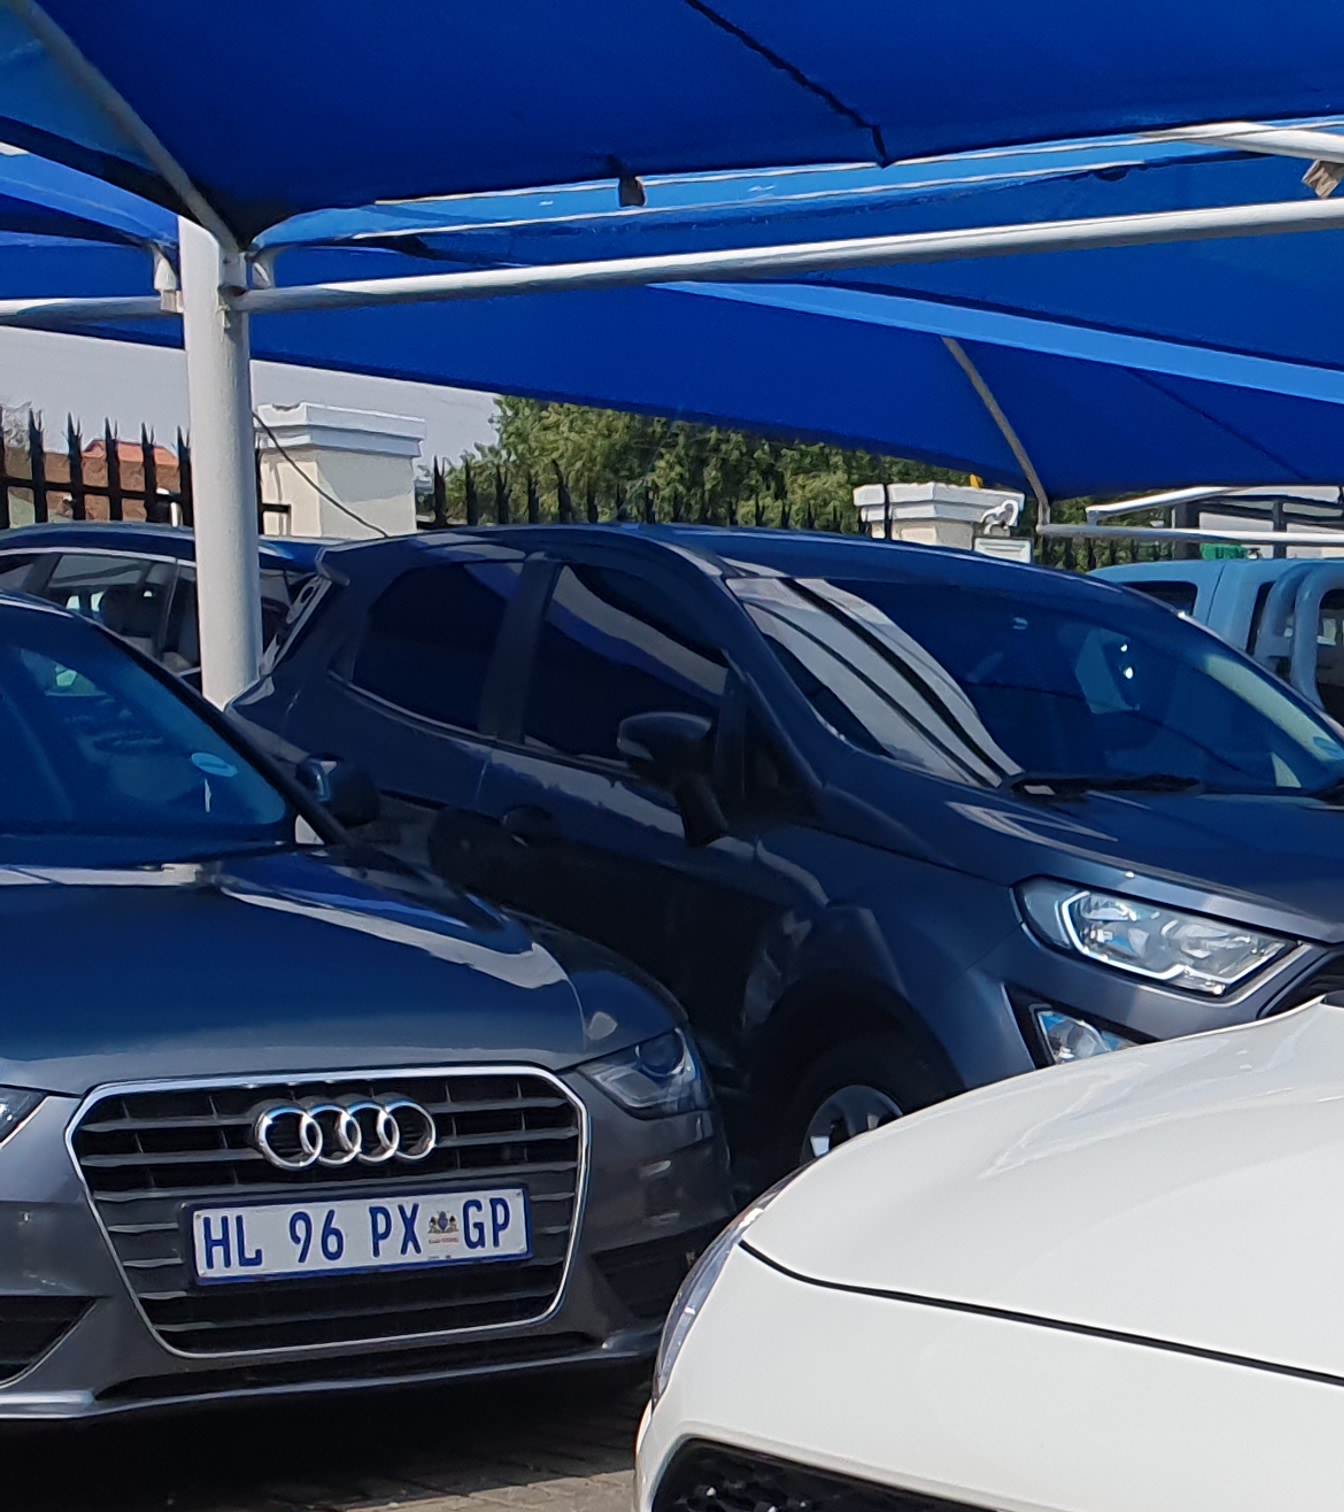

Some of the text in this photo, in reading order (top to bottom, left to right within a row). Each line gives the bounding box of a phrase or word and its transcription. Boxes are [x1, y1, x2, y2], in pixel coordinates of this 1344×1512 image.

[204, 1196, 512, 1271] HL 96 PX GP
